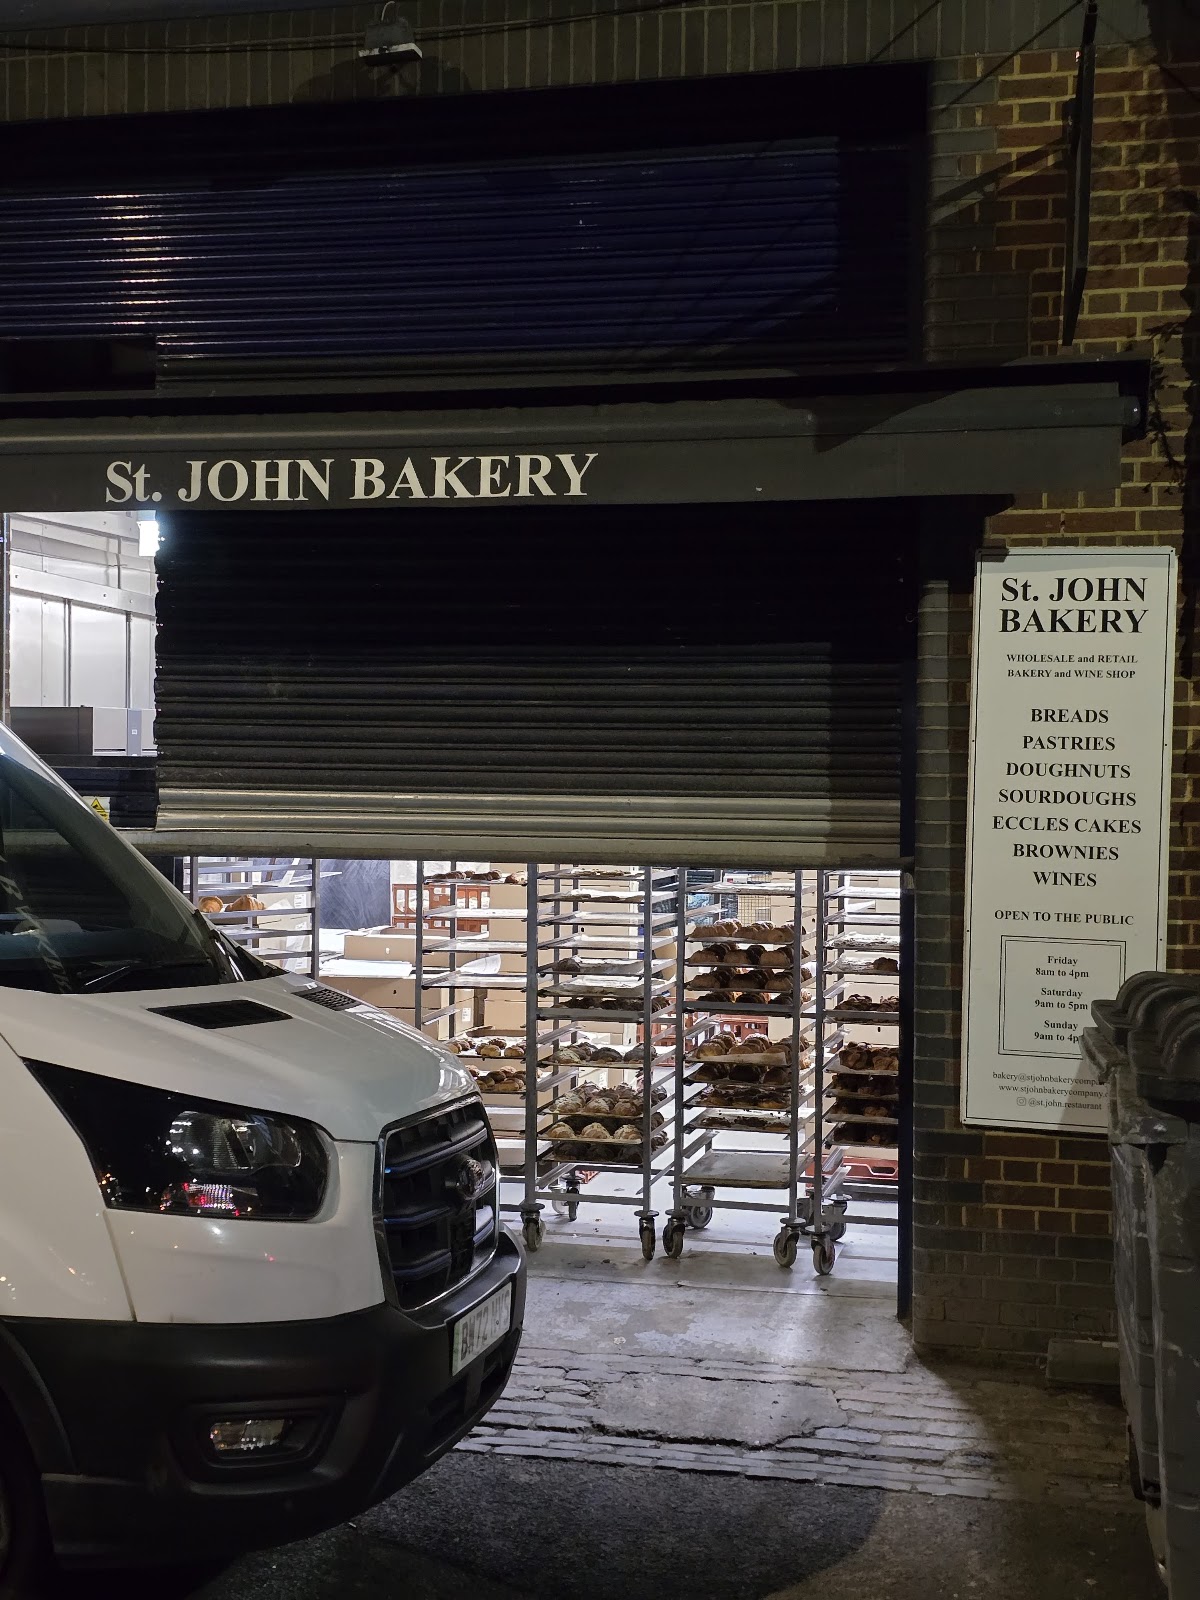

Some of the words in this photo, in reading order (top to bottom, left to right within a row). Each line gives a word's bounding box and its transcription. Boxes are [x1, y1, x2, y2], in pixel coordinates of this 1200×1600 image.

[105, 461, 162, 503] St.
[177, 459, 335, 502] JOHN
[349, 453, 599, 500] BAKERY
[1001, 577, 1039, 602] St.
[1048, 577, 1148, 603] JOHN
[998, 608, 1149, 634] BAKERY
[1006, 653, 1075, 663] WHOLESALE
[1077, 653, 1095, 664] and
[1097, 654, 1138, 664] RETAIL
[1007, 669, 1052, 679] BAKERY
[1054, 669, 1072, 679] and
[1073, 669, 1104, 679] WINE
[1106, 670, 1136, 679] SHOP
[1030, 708, 1109, 724] BREADS
[1022, 735, 1116, 752] PASTRIES
[1006, 762, 1131, 779] DOUGHNUTS
[998, 788, 1137, 807] SOURDOUGHS
[991, 815, 1069, 832] ECCLES
[1074, 817, 1142, 835] CAKES
[1012, 843, 1119, 861] BROWNIES
[1032, 870, 1097, 888] WINES
[994, 909, 1030, 921] OPEN
[1033, 911, 1051, 922] TO
[1054, 912, 1082, 923] THE
[1085, 913, 1135, 926] PUBLIC
[1047, 955, 1078, 967] Friday
[1035, 967, 1055, 977] 8am
[1058, 969, 1067, 977] to
[1069, 968, 1089, 979] 4pm
[1041, 987, 1083, 999] Saturday
[1034, 999, 1054, 1009] 9am
[1056, 1001, 1066, 1009] to
[1068, 1000, 1088, 1011] 5pm
[1044, 1019, 1079, 1031] Sunday
[1034, 1031, 1054, 1041] 9am
[1056, 1033, 1065, 1041] to
[1067, 1032, 1080, 1044] 4p
[992, 1071, 1101, 1086] bakery@stjohnbakerycomp
[998, 1084, 1109, 1099] www.stjohnbakerycompany.c
[1028, 1097, 1102, 1110] @st.john.restaurant
